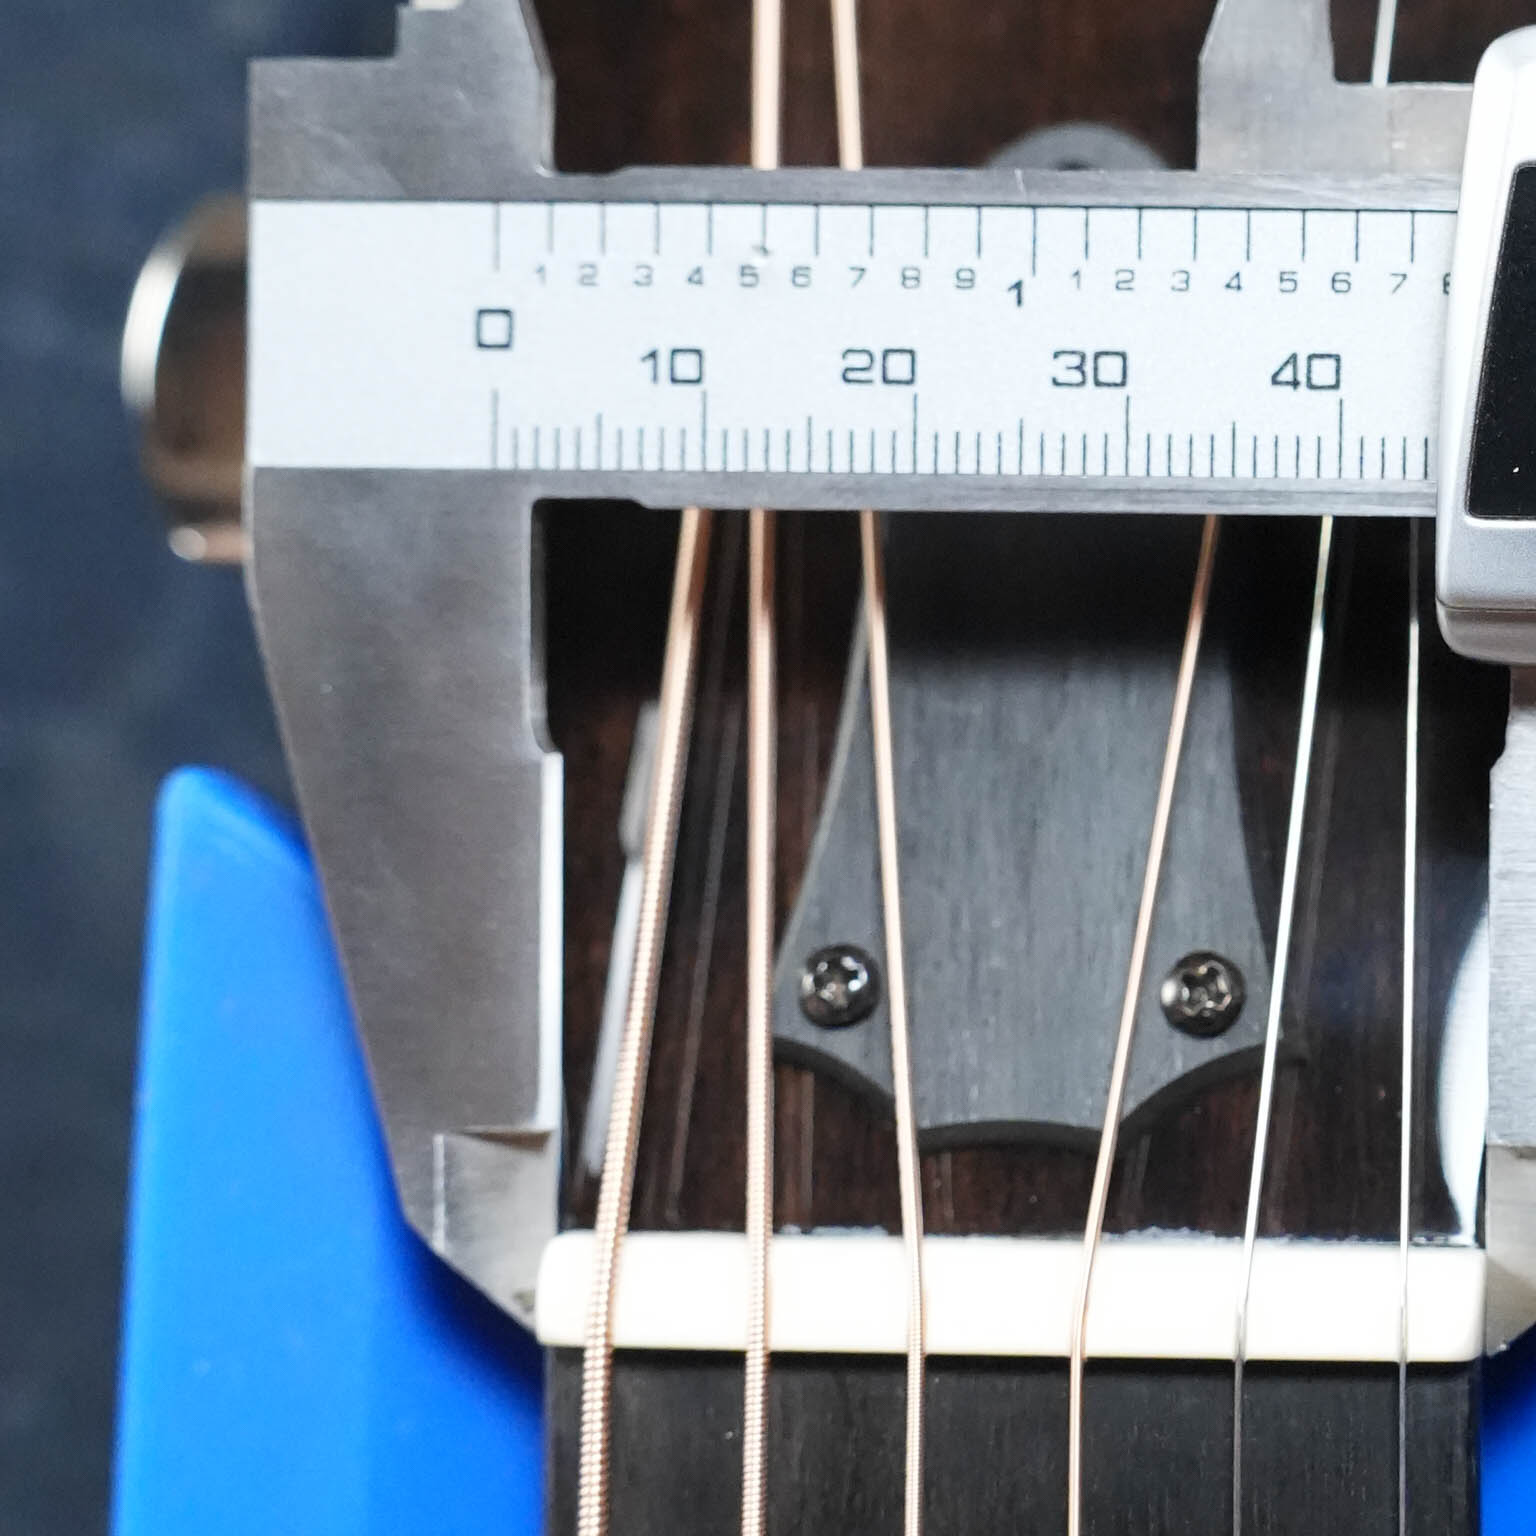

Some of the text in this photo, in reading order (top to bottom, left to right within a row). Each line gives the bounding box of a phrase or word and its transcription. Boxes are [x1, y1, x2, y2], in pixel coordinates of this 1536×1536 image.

[579, 263, 598, 287] 2
[633, 264, 653, 287] 3
[686, 265, 704, 287] 4
[739, 265, 759, 288] 5
[791, 265, 811, 288] 6
[849, 266, 867, 287] 7
[901, 267, 921, 289] 8
[954, 267, 976, 291] 9
[1114, 268, 1135, 292] 2
[1170, 269, 1191, 293] 3
[1223, 270, 1243, 294] 4
[1278, 270, 1299, 294] 5
[1330, 271, 1352, 294] 6
[1389, 272, 1408, 295] 7
[474, 307, 1343, 392] 0 10 20 30 40
